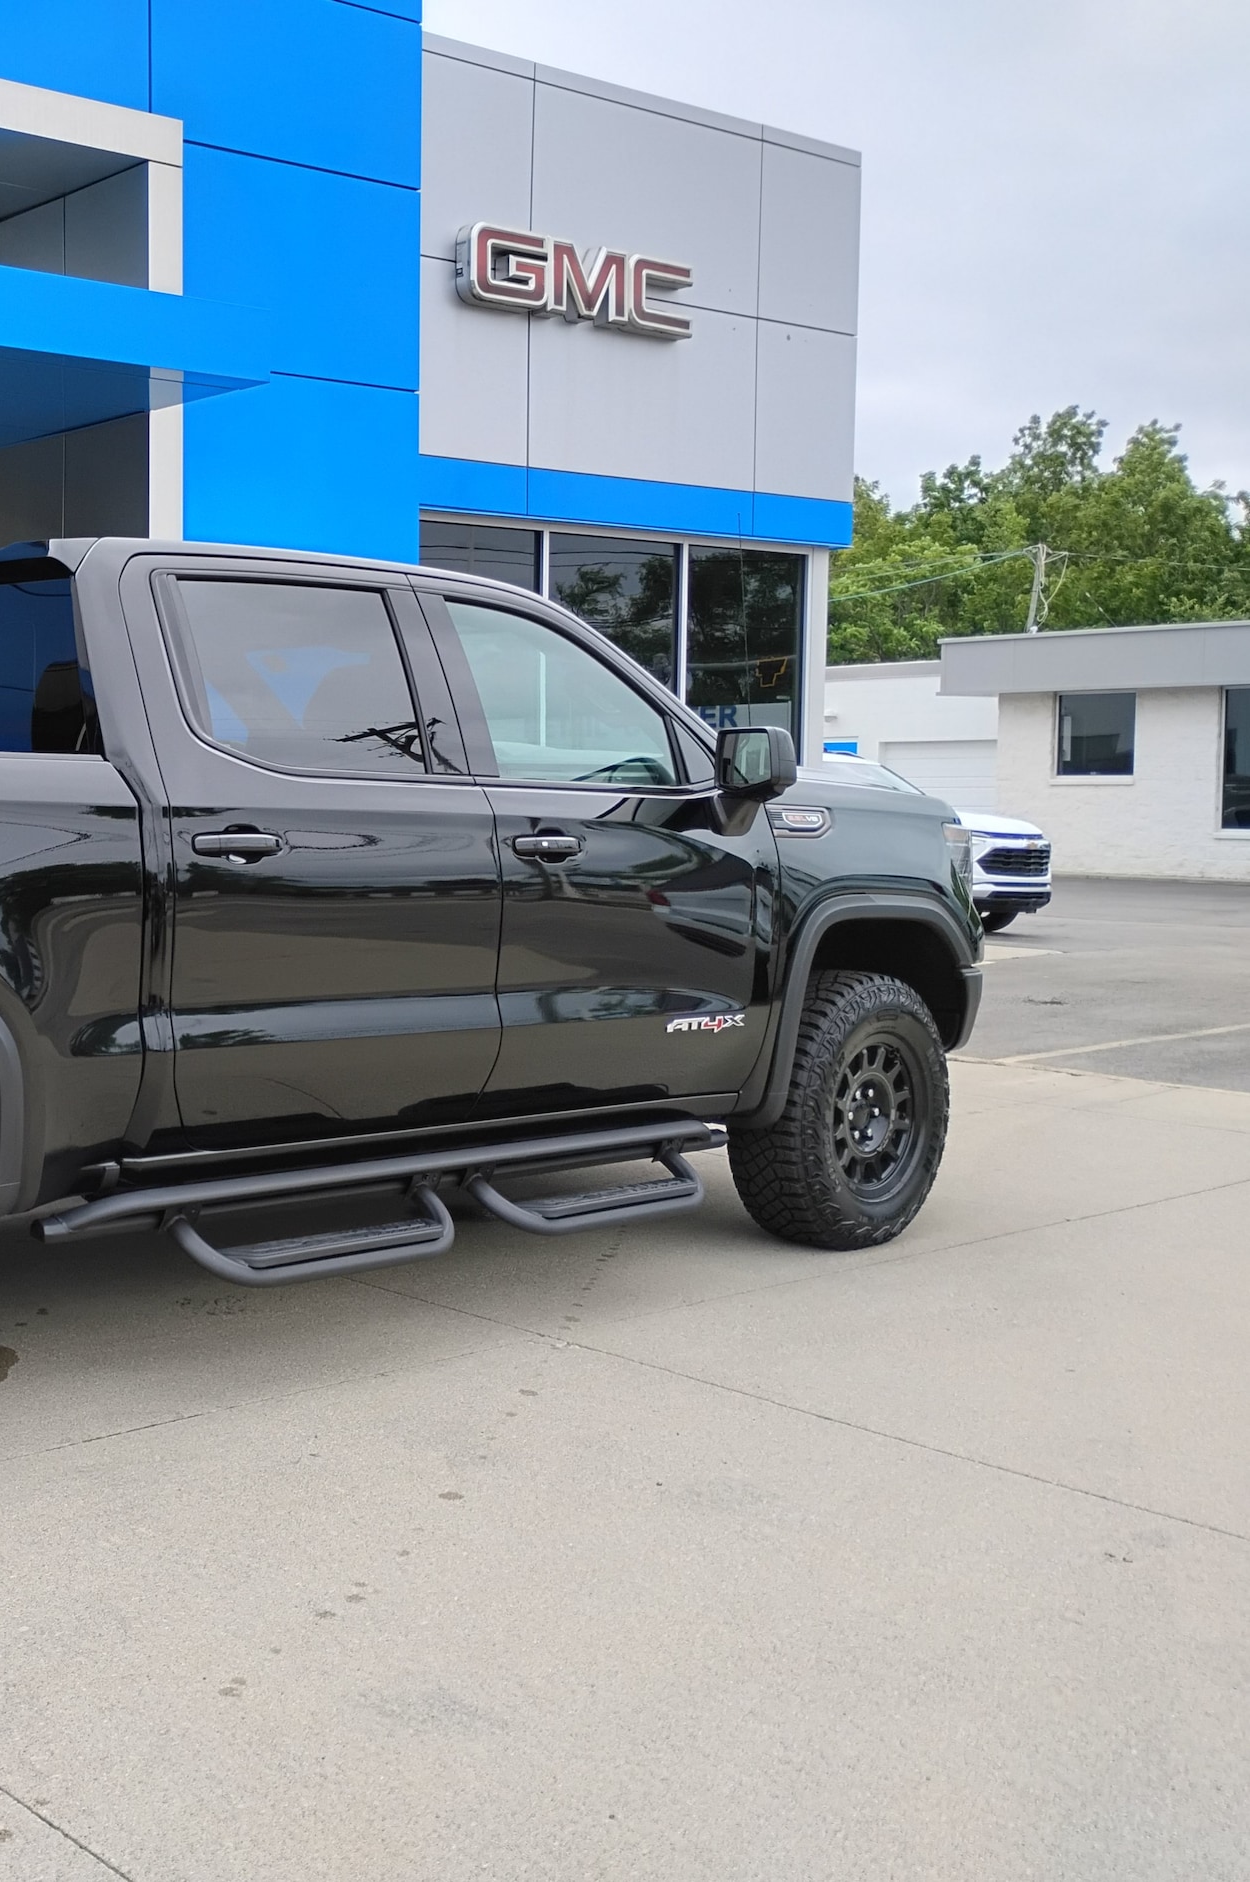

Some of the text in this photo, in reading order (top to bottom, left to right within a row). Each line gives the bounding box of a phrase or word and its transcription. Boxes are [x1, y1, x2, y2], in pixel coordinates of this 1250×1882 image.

[458, 221, 693, 340] GMC
[691, 705, 738, 728] ER
[666, 1014, 745, 1033] AT4X
